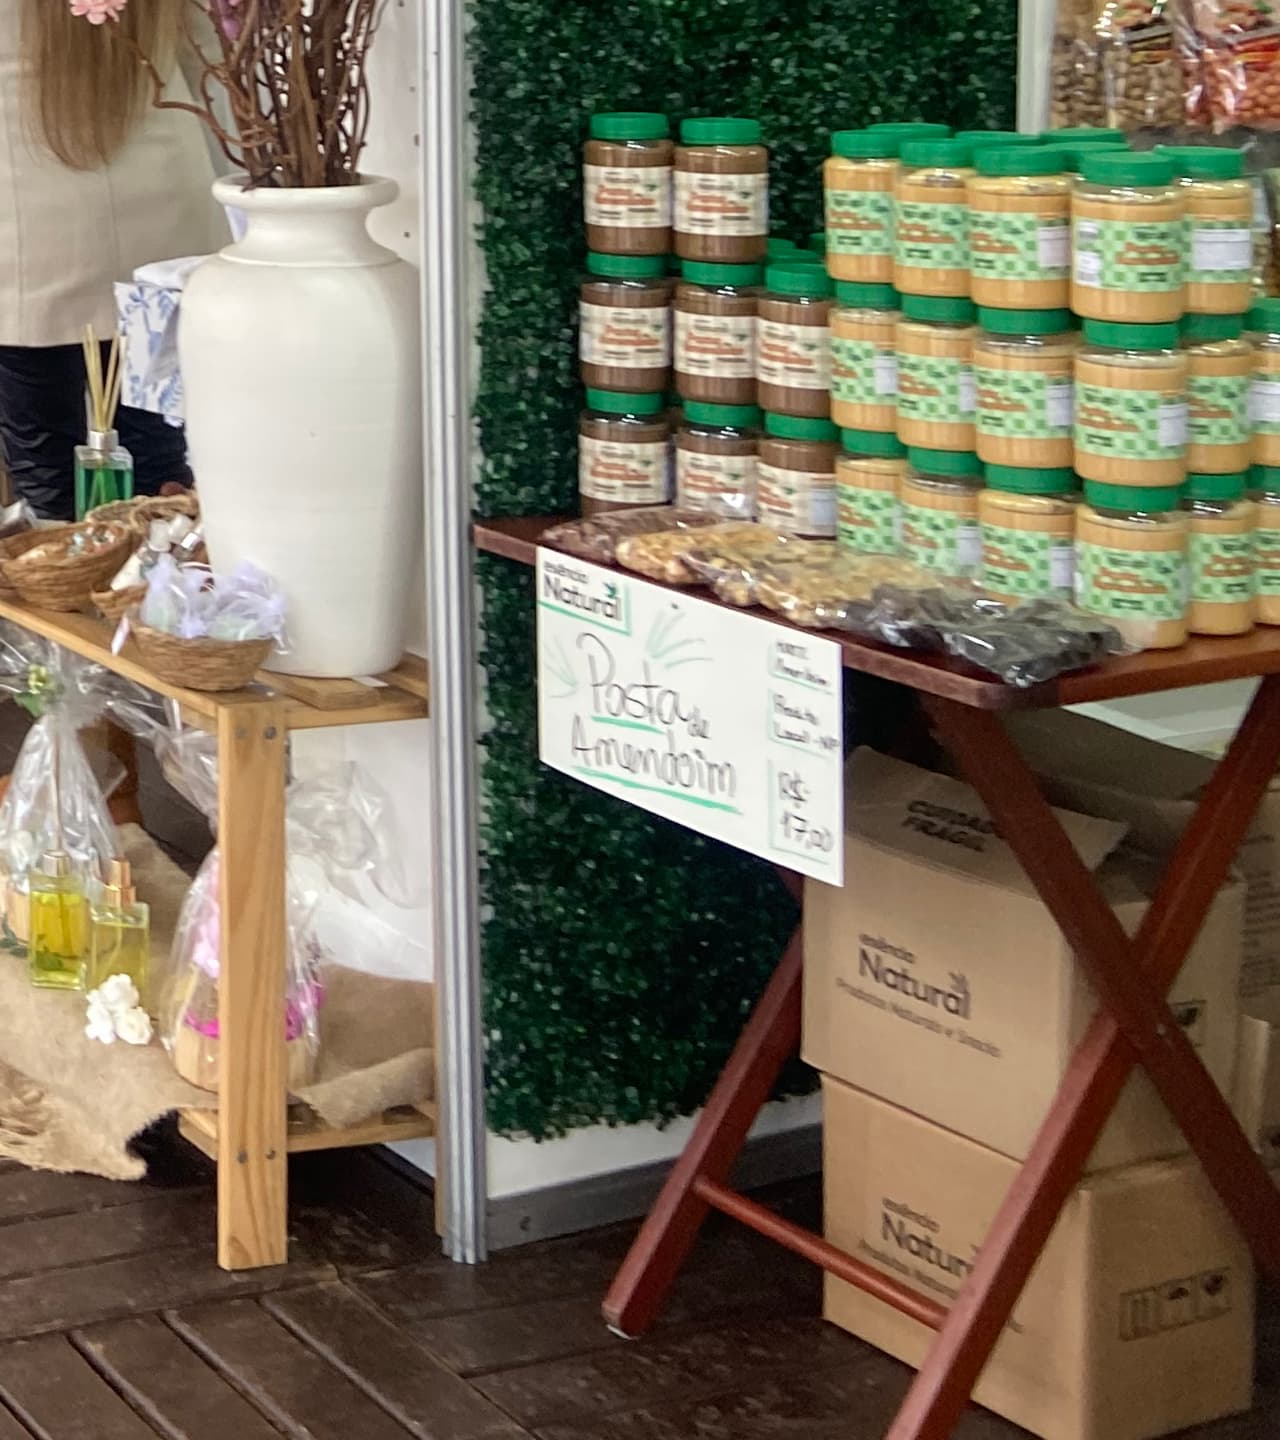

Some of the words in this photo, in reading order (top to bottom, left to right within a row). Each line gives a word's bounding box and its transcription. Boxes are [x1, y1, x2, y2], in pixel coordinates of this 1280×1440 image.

[576, 632, 690, 726] Pasta
[858, 946, 971, 1021] Natural
[881, 1212, 975, 1279] Natur
